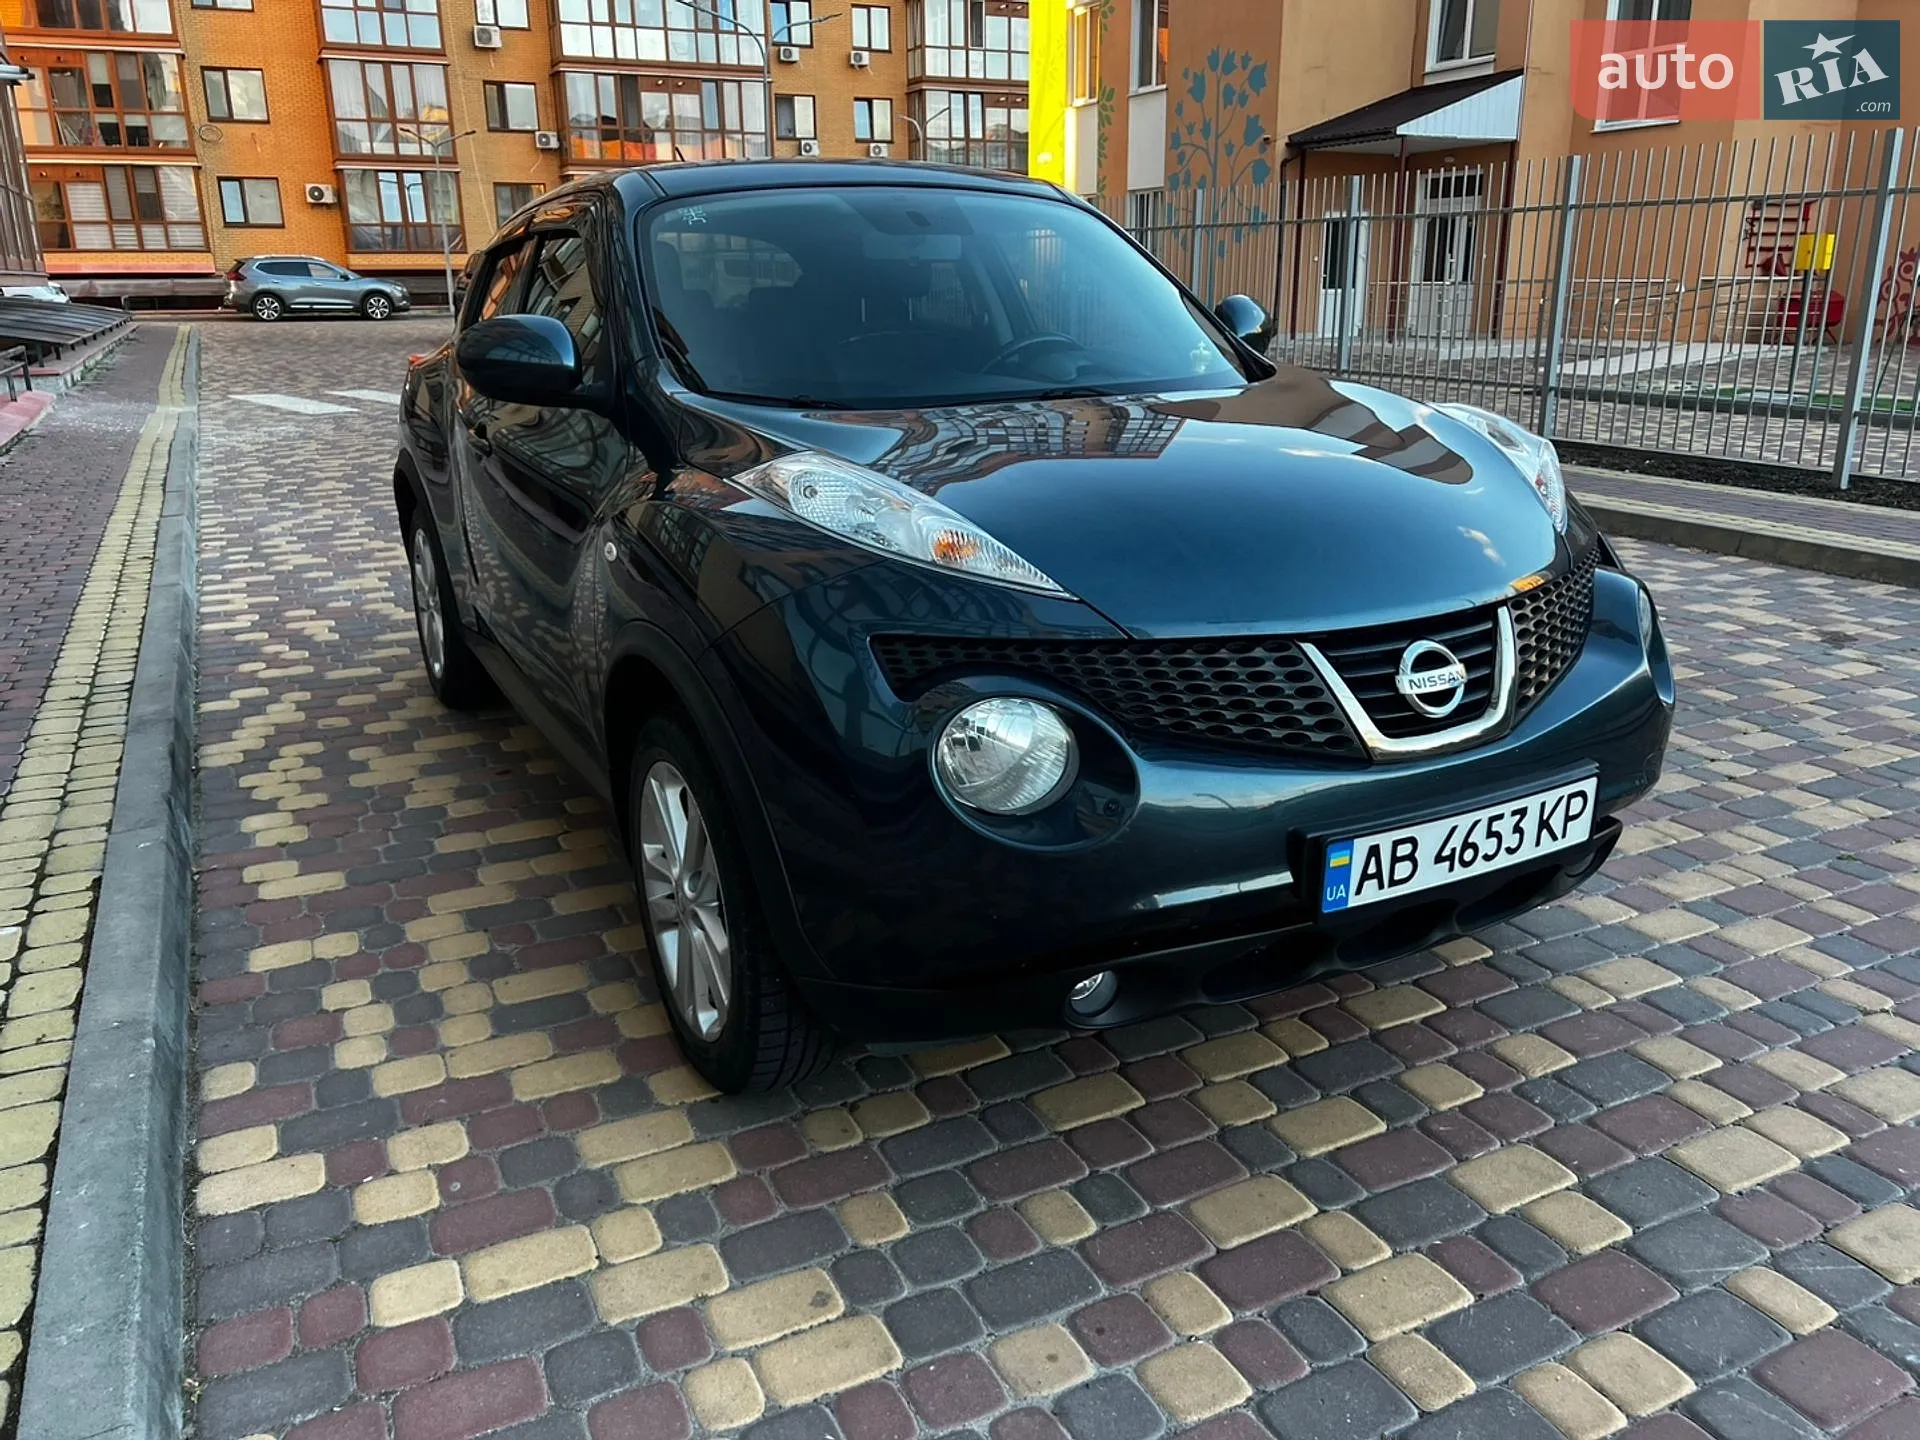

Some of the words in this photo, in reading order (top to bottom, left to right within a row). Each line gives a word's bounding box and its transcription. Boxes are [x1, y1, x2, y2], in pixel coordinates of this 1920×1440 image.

[1408, 670, 1464, 690] NISSAN
[1355, 835, 1419, 896] AB
[1433, 806, 1529, 873] 4653
[1535, 789, 1589, 848] KP
[1326, 884, 1347, 902] UA
